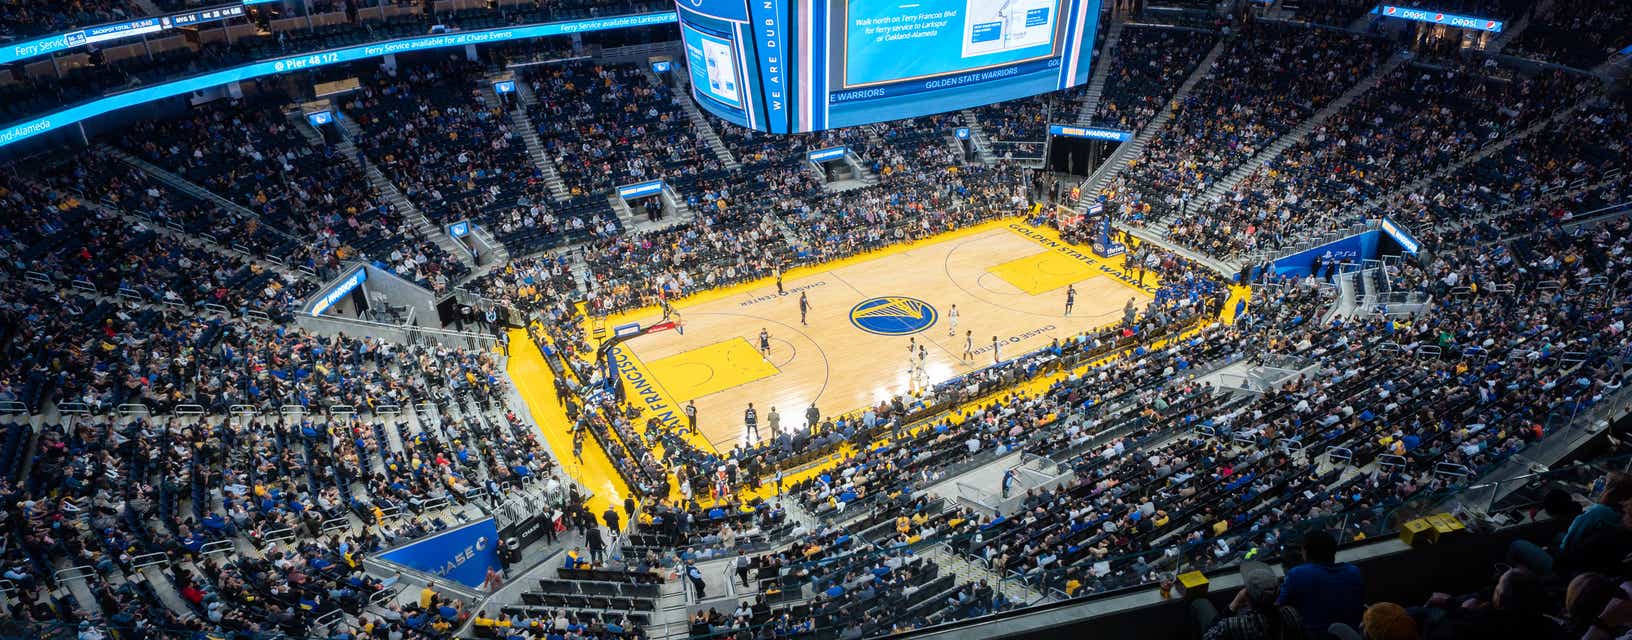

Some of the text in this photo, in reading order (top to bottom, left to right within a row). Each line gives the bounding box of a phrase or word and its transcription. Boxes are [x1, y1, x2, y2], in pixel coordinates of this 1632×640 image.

[855, 17, 871, 26] Walk
[872, 16, 890, 24] north
[1402, 11, 1427, 20] pepsi
[1451, 18, 1477, 27] pepsi
[561, 23, 577, 32] Ferry
[579, 21, 600, 29] Service
[602, 19, 629, 27] available
[765, 19, 775, 47] DUB
[875, 26, 890, 34] ferry
[365, 46, 383, 55] Ferry
[384, 42, 410, 51] Service
[411, 38, 443, 48] available
[457, 35, 465, 43] all
[465, 33, 488, 42] Chase
[489, 31, 512, 40] Events
[15, 45, 38, 57] Ferry
[274, 53, 338, 72] @ Pier 48 1/2
[768, 57, 778, 83] ARE
[925, 67, 1018, 89] GOLDEN STATE WARRIORS
[772, 91, 781, 110] WE
[830, 88, 885, 102] E WARRIORS
[0, 119, 50, 143] nd-Alameda
[1085, 129, 1120, 140] WARRIORS
[1009, 223, 1060, 249] GOLDEN
[1058, 246, 1097, 266] STATE
[1107, 245, 1125, 255] thrive
[791, 281, 826, 294] CHASE
[1020, 324, 1056, 340] CHASE
[612, 347, 668, 411] FRANCISCO
